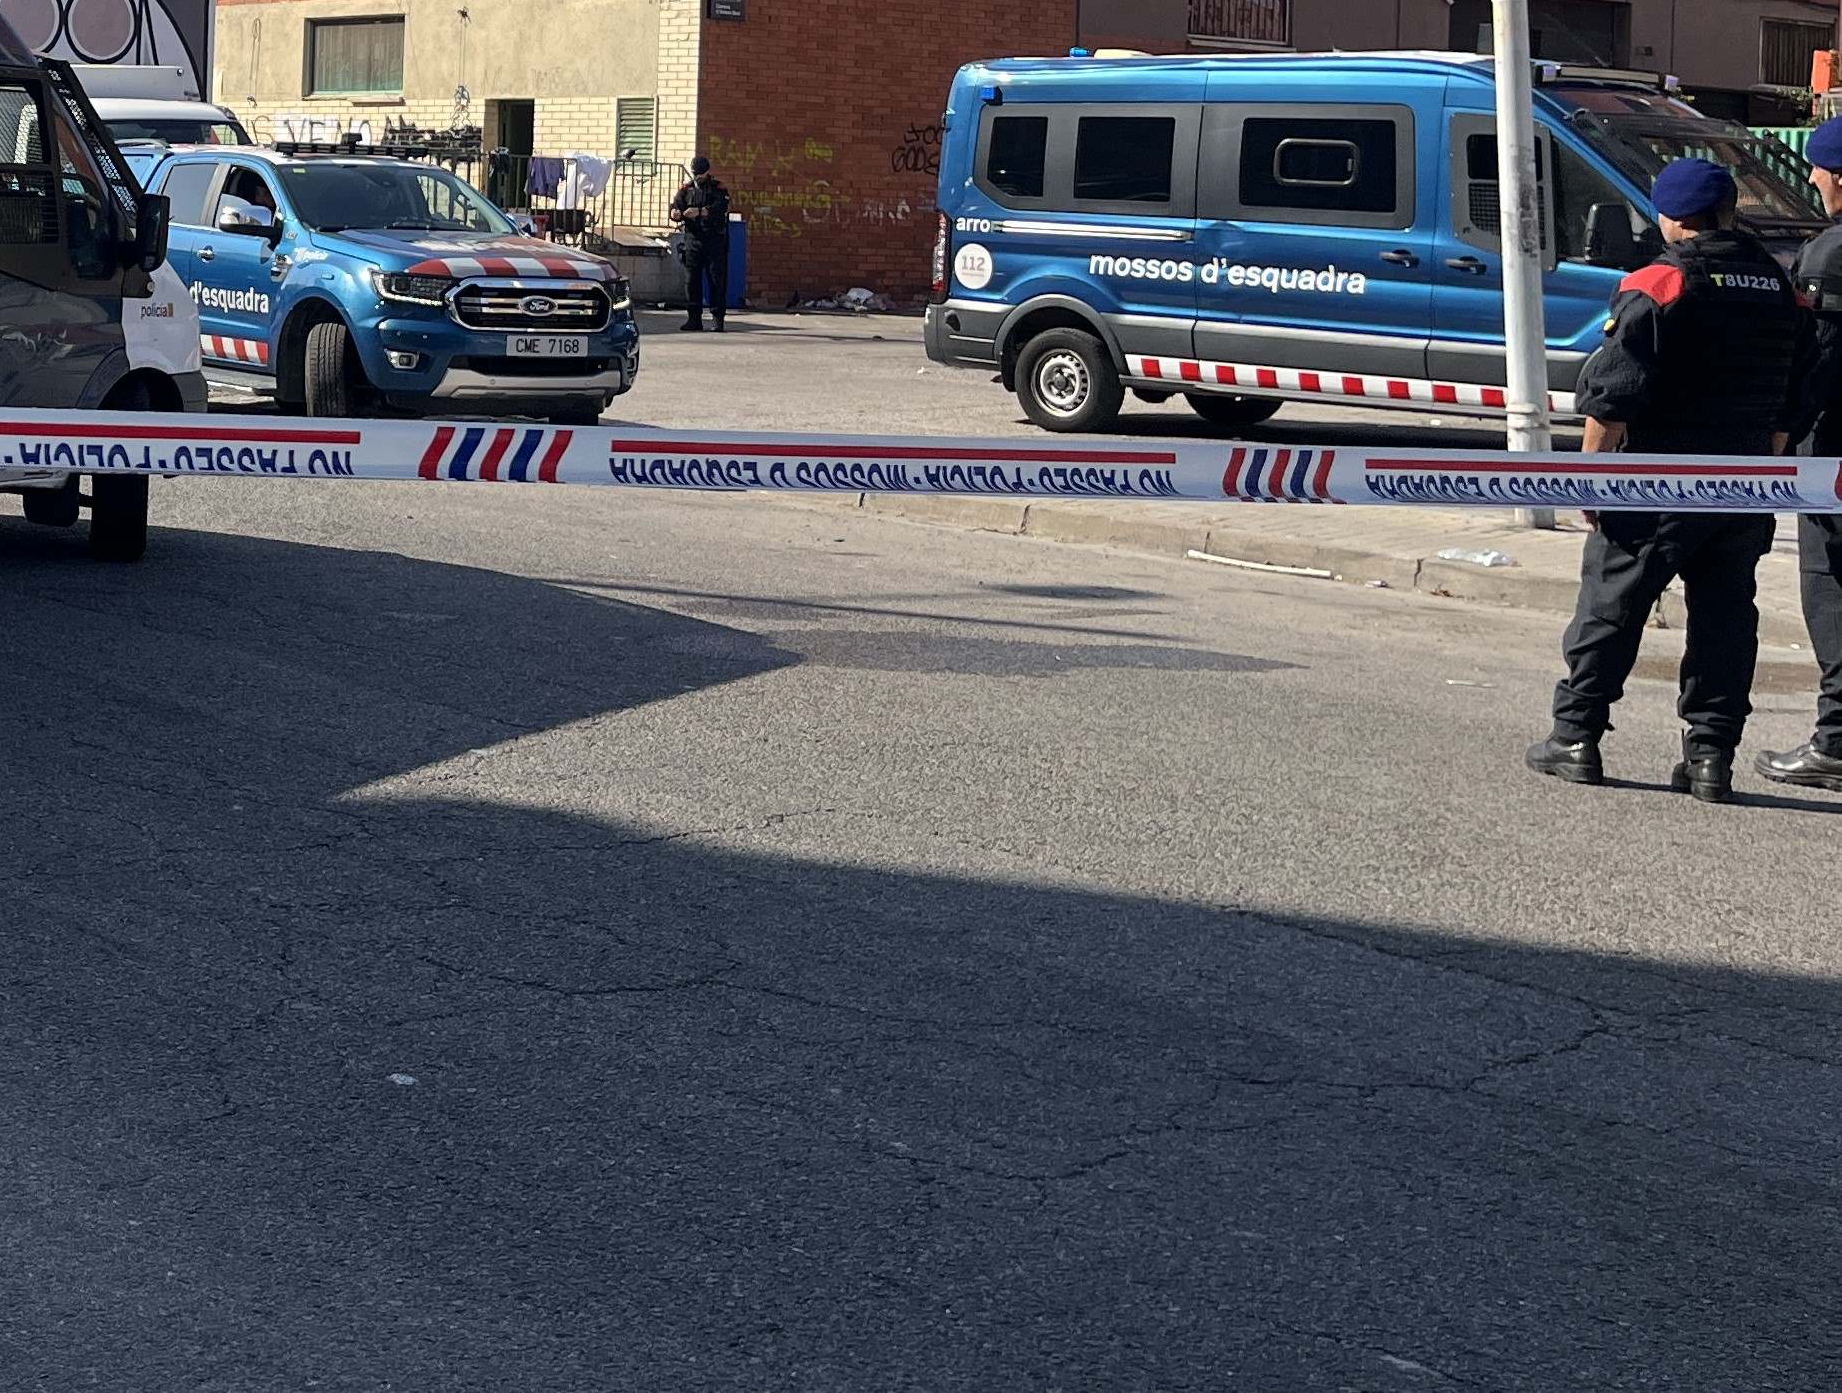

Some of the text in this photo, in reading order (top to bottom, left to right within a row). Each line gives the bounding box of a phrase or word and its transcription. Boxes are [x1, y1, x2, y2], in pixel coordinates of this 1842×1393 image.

[955, 216, 991, 233] arro
[961, 255, 985, 271] 112
[1089, 254, 1366, 295] mossos d'esquadra
[189, 281, 270, 314] d'esquadra
[515, 338, 580, 354] CME 7168
